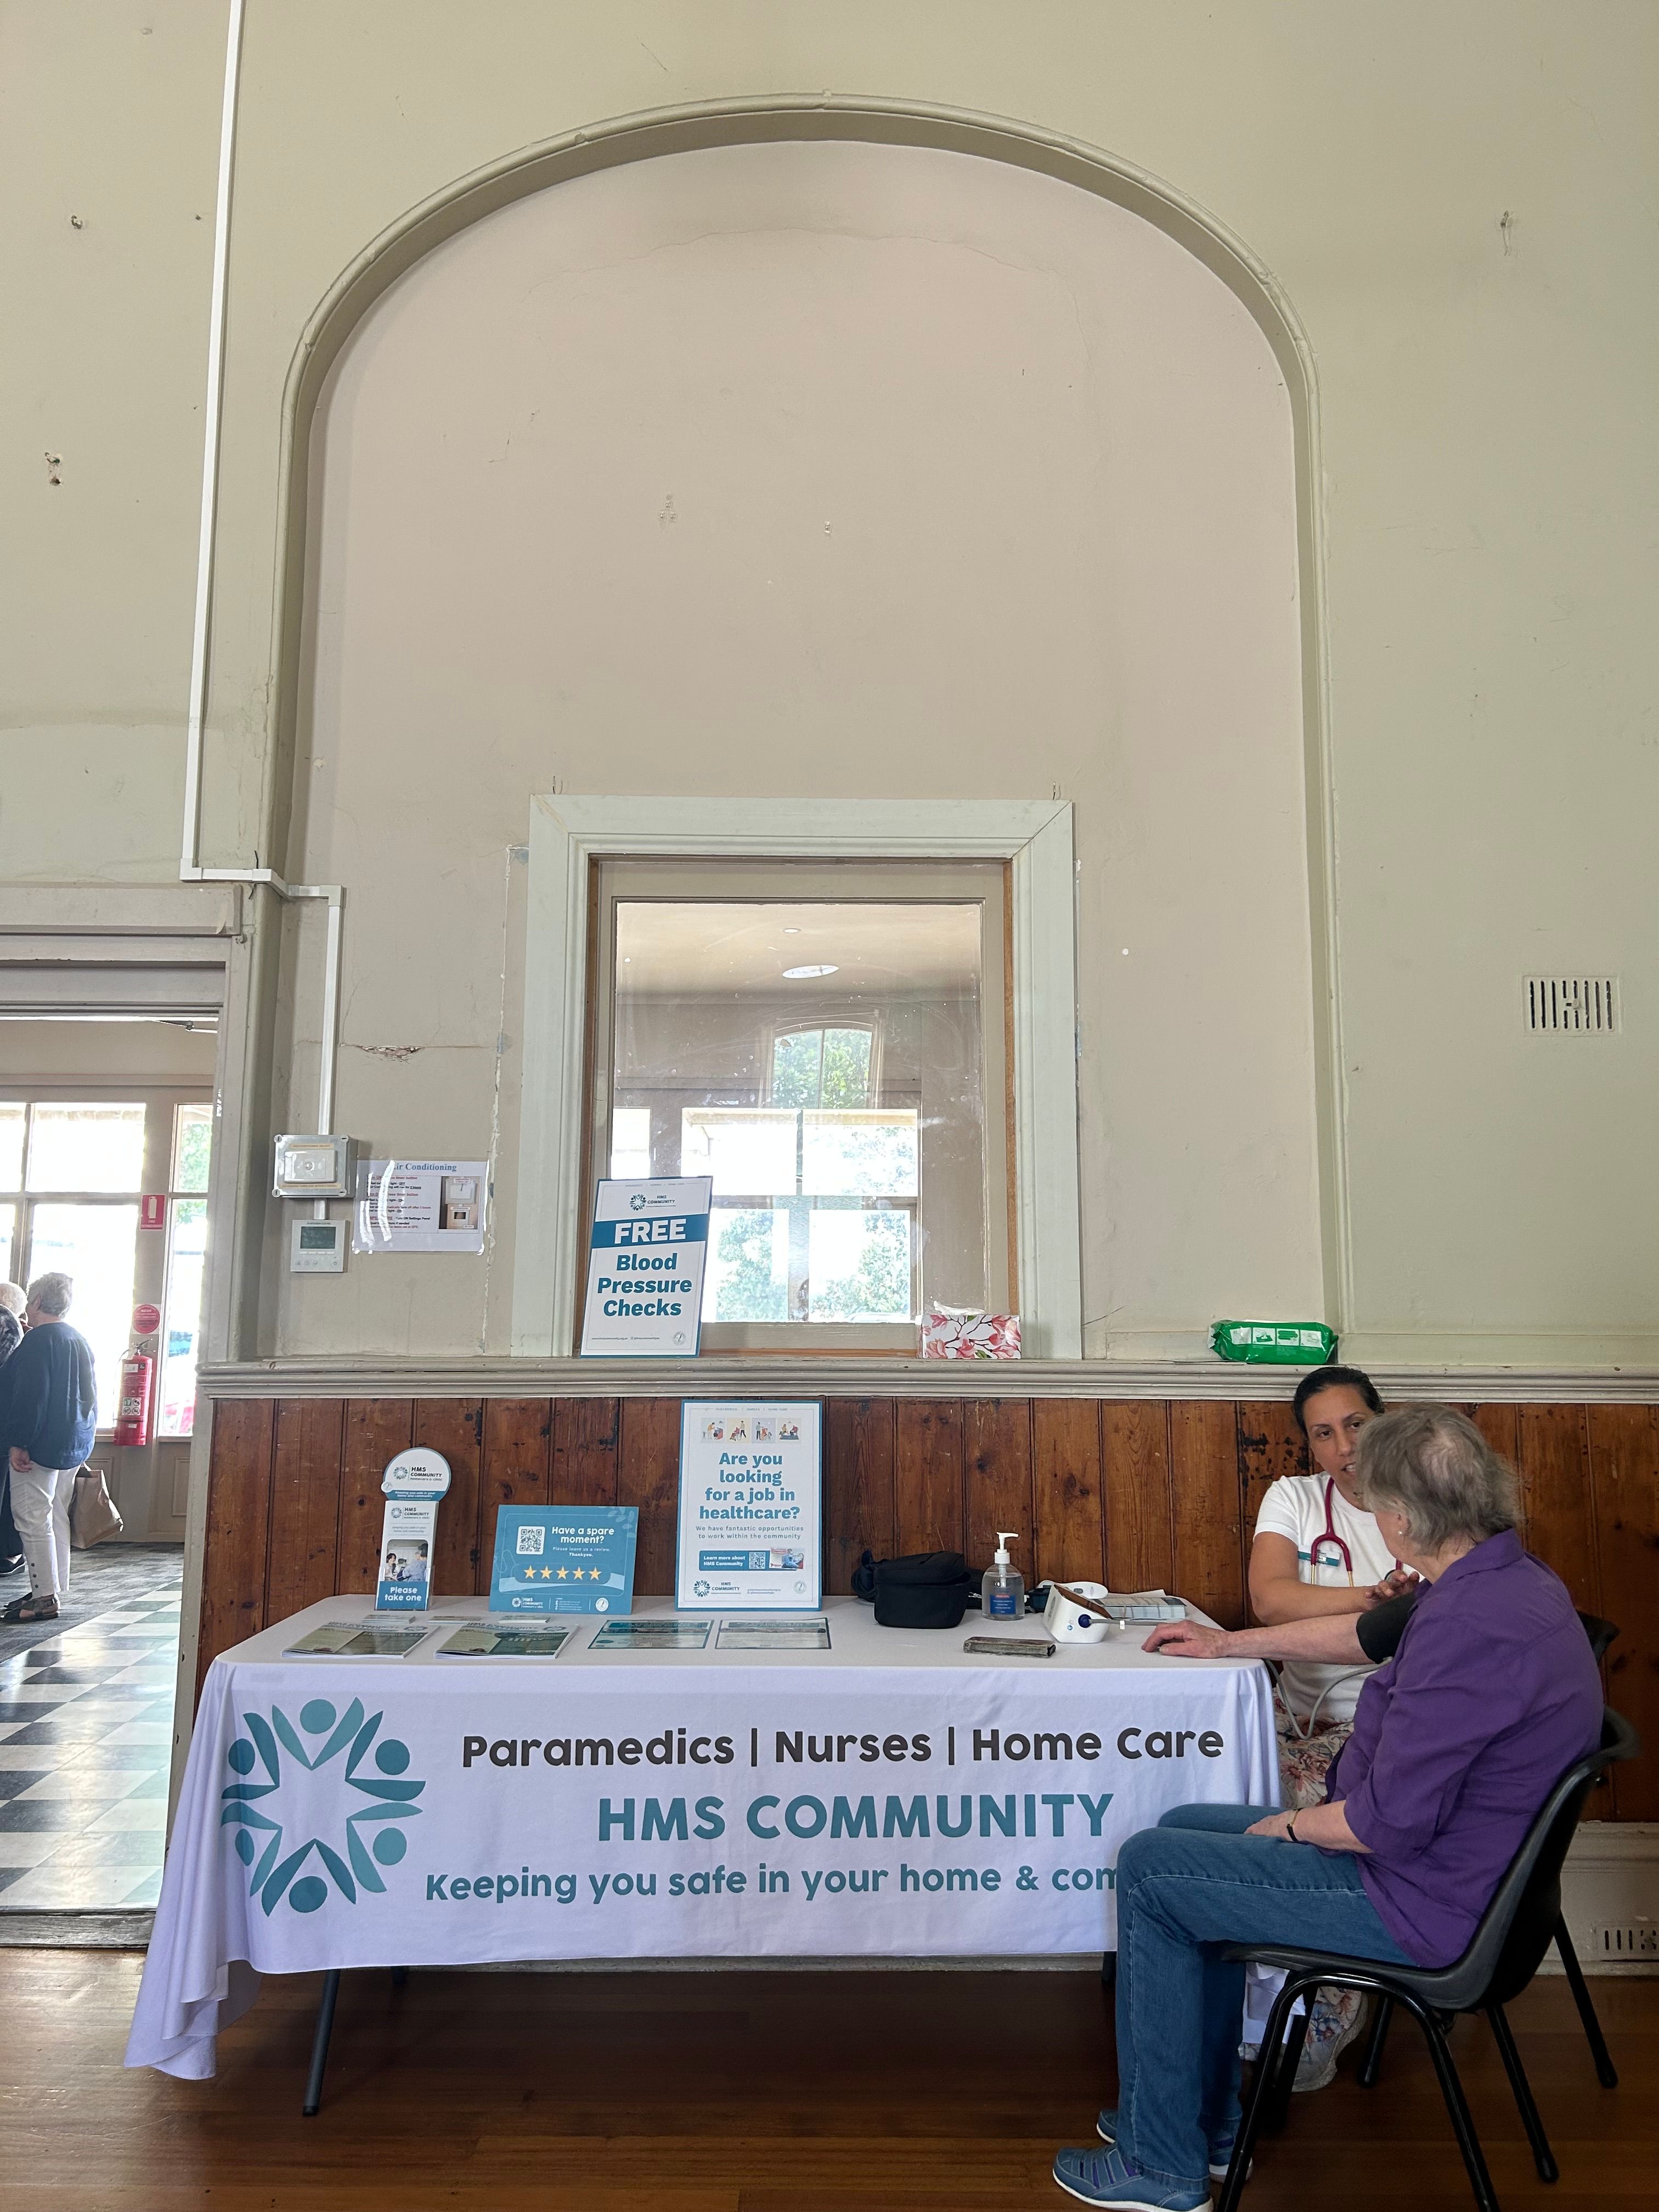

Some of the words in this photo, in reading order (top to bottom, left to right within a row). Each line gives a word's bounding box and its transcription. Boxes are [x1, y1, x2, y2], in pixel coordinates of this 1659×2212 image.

[406, 1163, 457, 1172] Conditioning
[614, 1218, 687, 1244] FREE
[616, 1253, 678, 1271] Blood
[597, 1277, 692, 1294] Pressure
[603, 1299, 681, 1317] Checks
[719, 1452, 748, 1465] Are
[752, 1455, 782, 1468] you
[720, 1469, 782, 1486] looking
[705, 1487, 730, 1500] for
[735, 1491, 744, 1500] a
[747, 1487, 775, 1504] job
[780, 1487, 795, 1500] in
[699, 1505, 800, 1519] healthcare?
[552, 1526, 575, 1534] Have
[586, 1528, 614, 1536] spare
[561, 1536, 605, 1544] moment?
[463, 1728, 735, 1768] Paramedics
[776, 1731, 932, 1763] Nurses
[973, 1729, 1102, 1761] Home
[1118, 1727, 1224, 1759] Care
[599, 1796, 725, 1841] HMS
[746, 1793, 1114, 1839] COMMUNITY
[426, 1866, 577, 1904] Keeping
[588, 1872, 657, 1905] you
[668, 1864, 747, 1897] safe
[759, 1863, 789, 1893] in
[801, 1869, 889, 1901] your
[900, 1863, 1001, 1892] home
[1015, 1865, 1040, 1891] &
